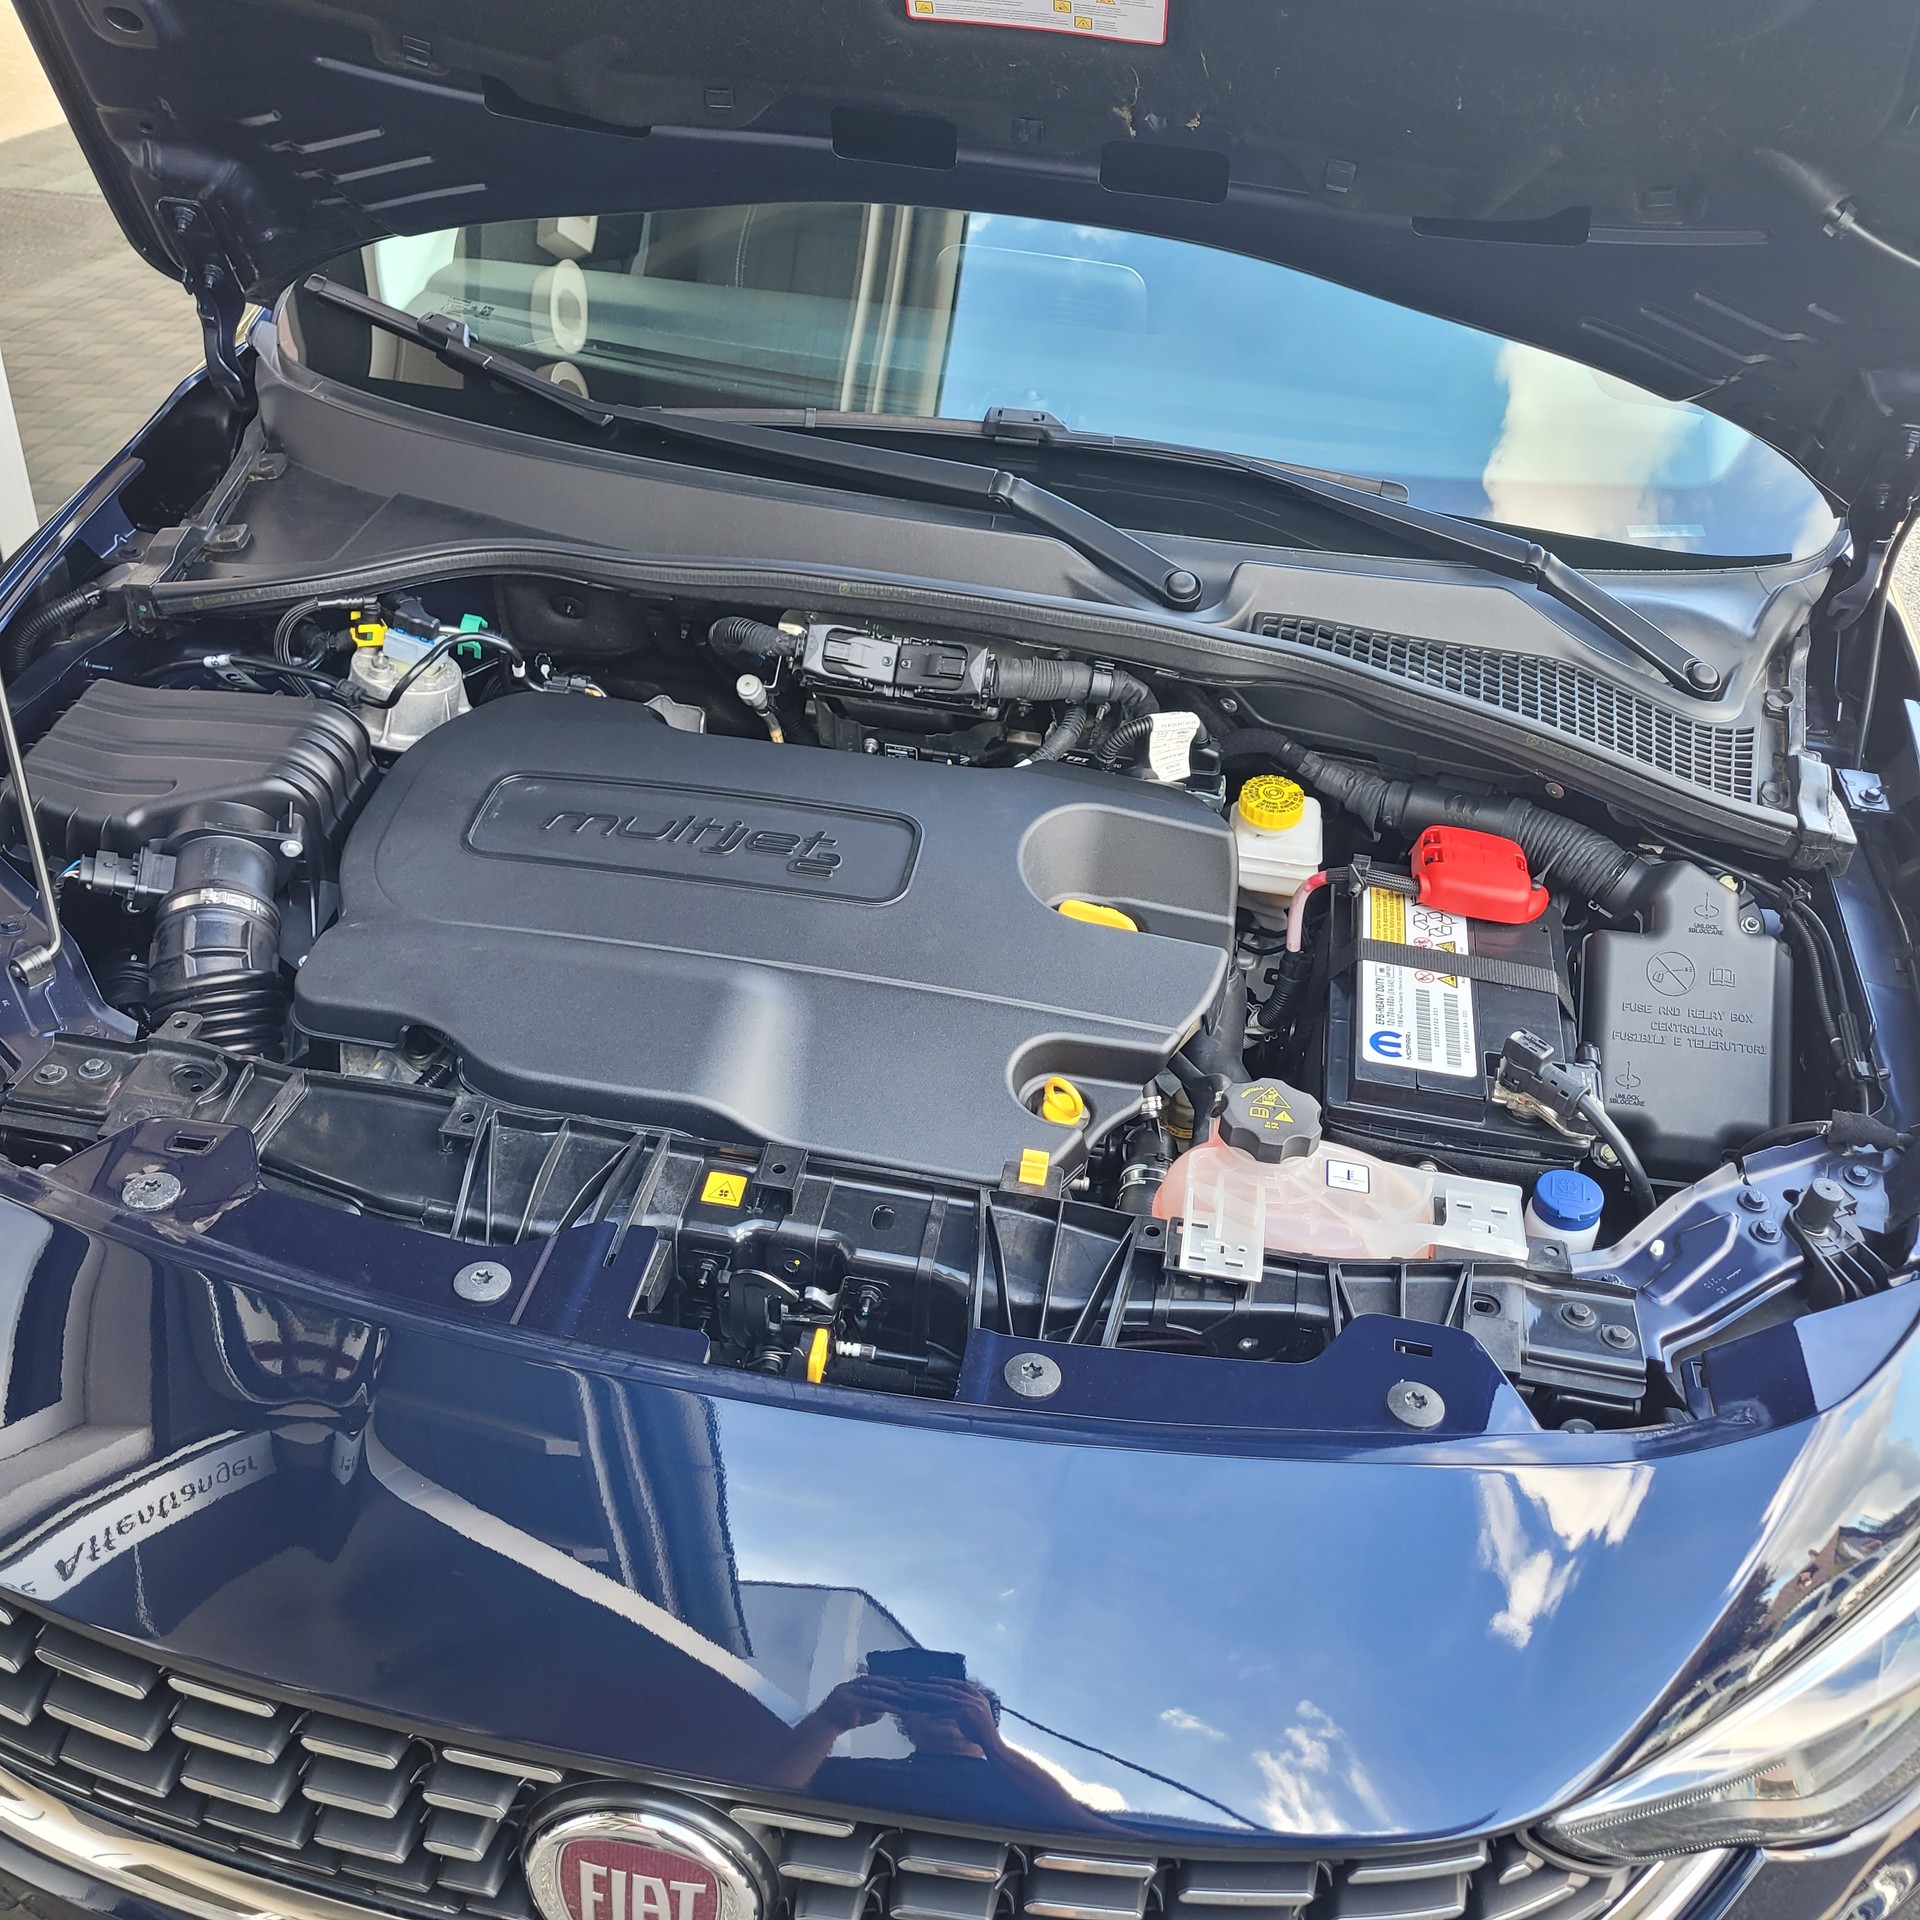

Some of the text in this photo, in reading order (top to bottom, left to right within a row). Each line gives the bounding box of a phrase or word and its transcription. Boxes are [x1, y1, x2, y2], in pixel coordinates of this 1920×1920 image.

[540, 811, 837, 858] multijet
[1375, 977, 1385, 1025] EFB-HEAVY DUTY
[1622, 1002, 1754, 1024] FUSE AND RELAY BOX
[1650, 1020, 1723, 1037] CENTRALINA
[1612, 1030, 1767, 1056] FUSIBILI E TELERUTTORI
[1615, 1093, 1640, 1101] UNLOCK
[579, 1859, 707, 1920] FIAT
